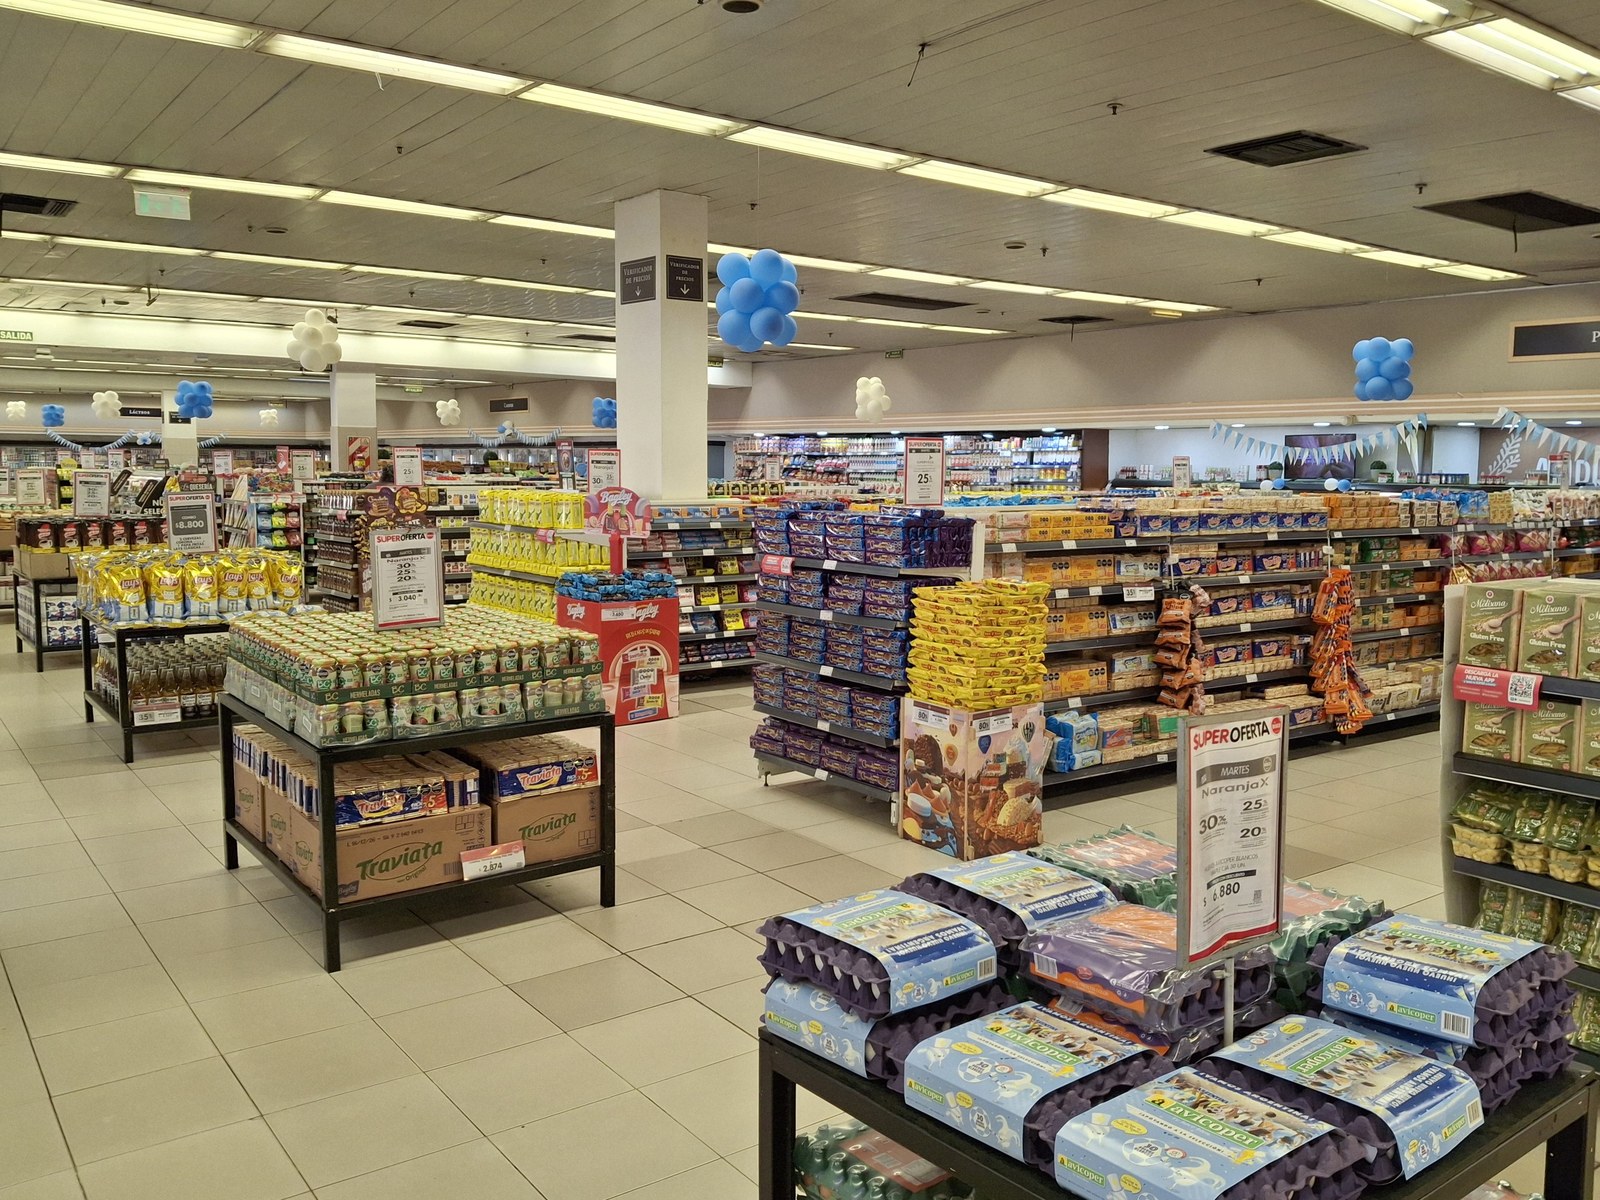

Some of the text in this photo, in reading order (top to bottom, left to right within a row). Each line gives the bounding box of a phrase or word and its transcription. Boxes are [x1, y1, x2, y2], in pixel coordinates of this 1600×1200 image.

[623, 266, 652, 276] VERIFICADOR
[633, 274, 651, 283] PRECIOS
[0, 331, 32, 340] SALIDA
[600, 490, 632, 506] Bagley
[377, 533, 425, 543] SUPEROFERTA
[636, 603, 659, 621] agley
[1464, 669, 1491, 677] DESCARGA
[1194, 721, 1270, 750] SUPEROFERTA
[521, 767, 562, 786] Traviata
[1220, 765, 1250, 776] MARTES
[358, 794, 404, 812] Traviata
[519, 813, 576, 840] Traviata
[356, 841, 443, 880] Traviata
[483, 862, 502, 873] 2.874
[406, 865, 426, 881] Original
[1213, 882, 1240, 901] 6.880
[950, 970, 974, 984] avicoper
[772, 1014, 798, 1032] avicoper
[1397, 1005, 1435, 1023] avicoper
[1005, 1030, 1078, 1065] avicoper
[1297, 1042, 1348, 1072] avicoper
[915, 1084, 943, 1102] avicoper
[1171, 1104, 1260, 1147] avicoper
[1068, 1160, 1105, 1184] avicoper
